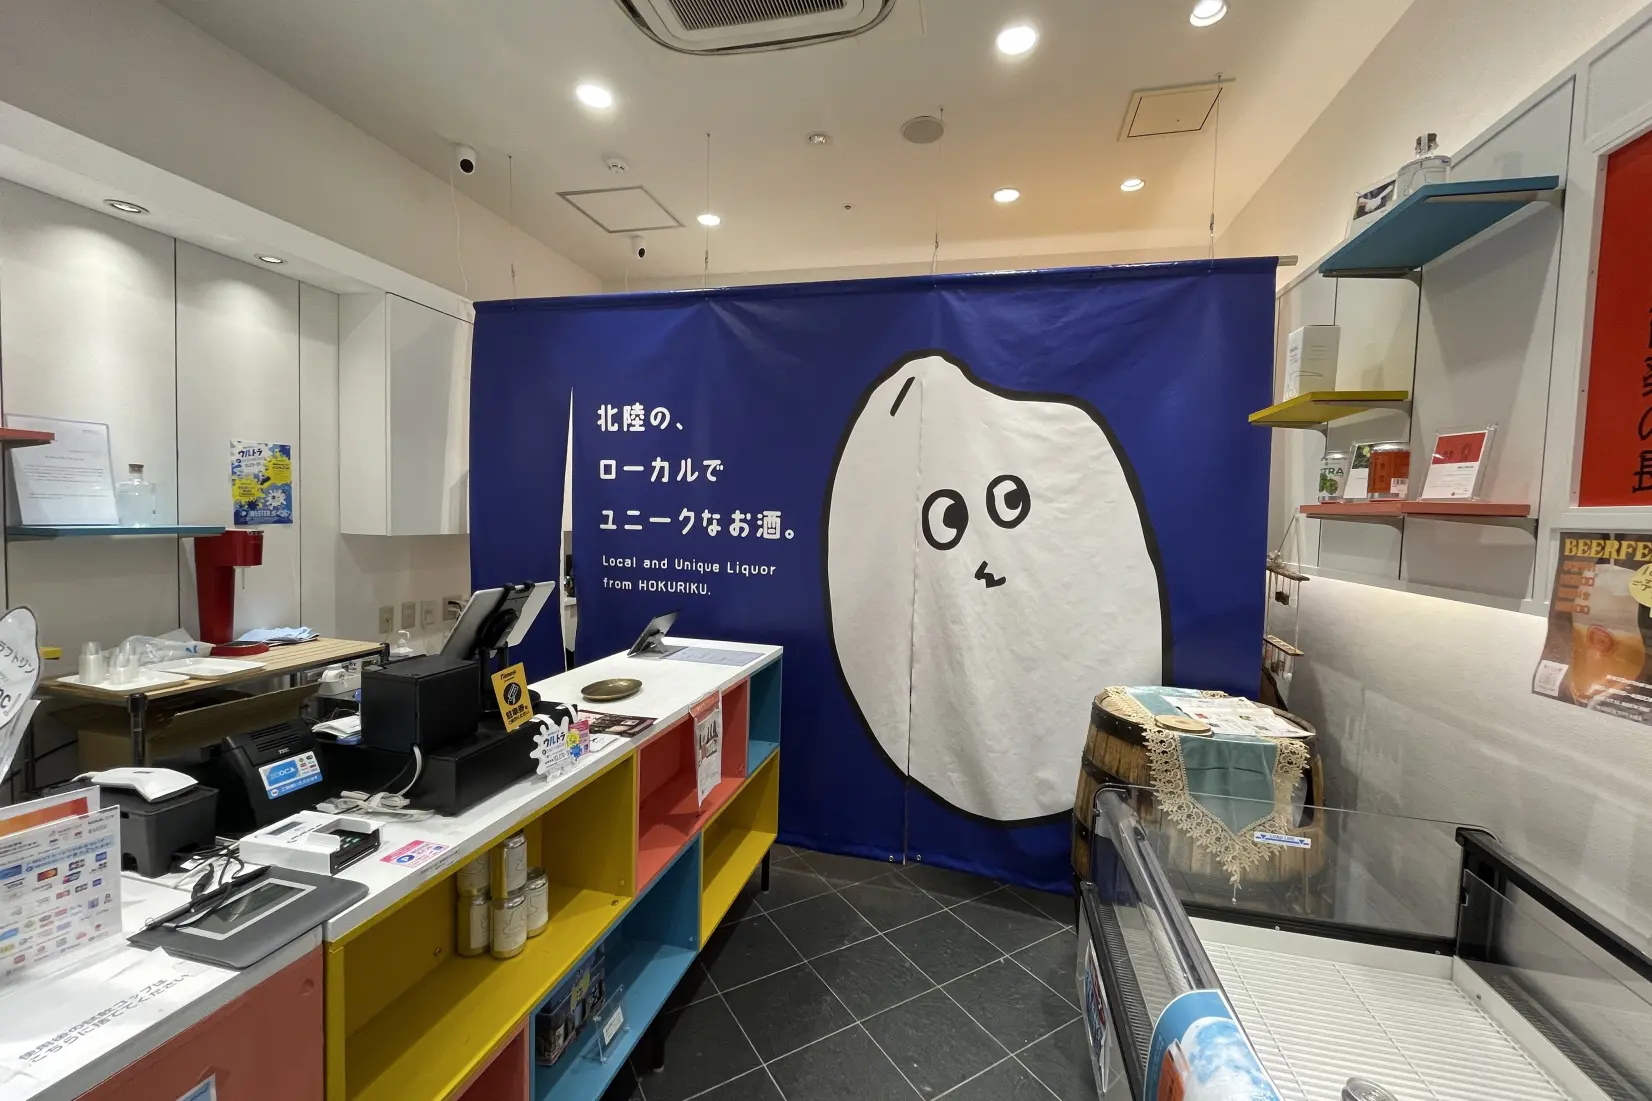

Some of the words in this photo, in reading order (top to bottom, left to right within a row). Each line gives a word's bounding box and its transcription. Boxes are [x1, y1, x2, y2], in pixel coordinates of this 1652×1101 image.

[597, 402, 683, 432] 北陸の、
[600, 456, 724, 483] ローカルで
[600, 508, 795, 539] ユニークなお酒。
[602, 555, 637, 568] Local
[643, 558, 668, 570] and
[675, 559, 720, 574] Unique
[727, 562, 777, 577] Liquor
[603, 577, 632, 590] from
[639, 580, 711, 595] HOKURIKU.
[543, 731, 566, 747] ウルトラ
